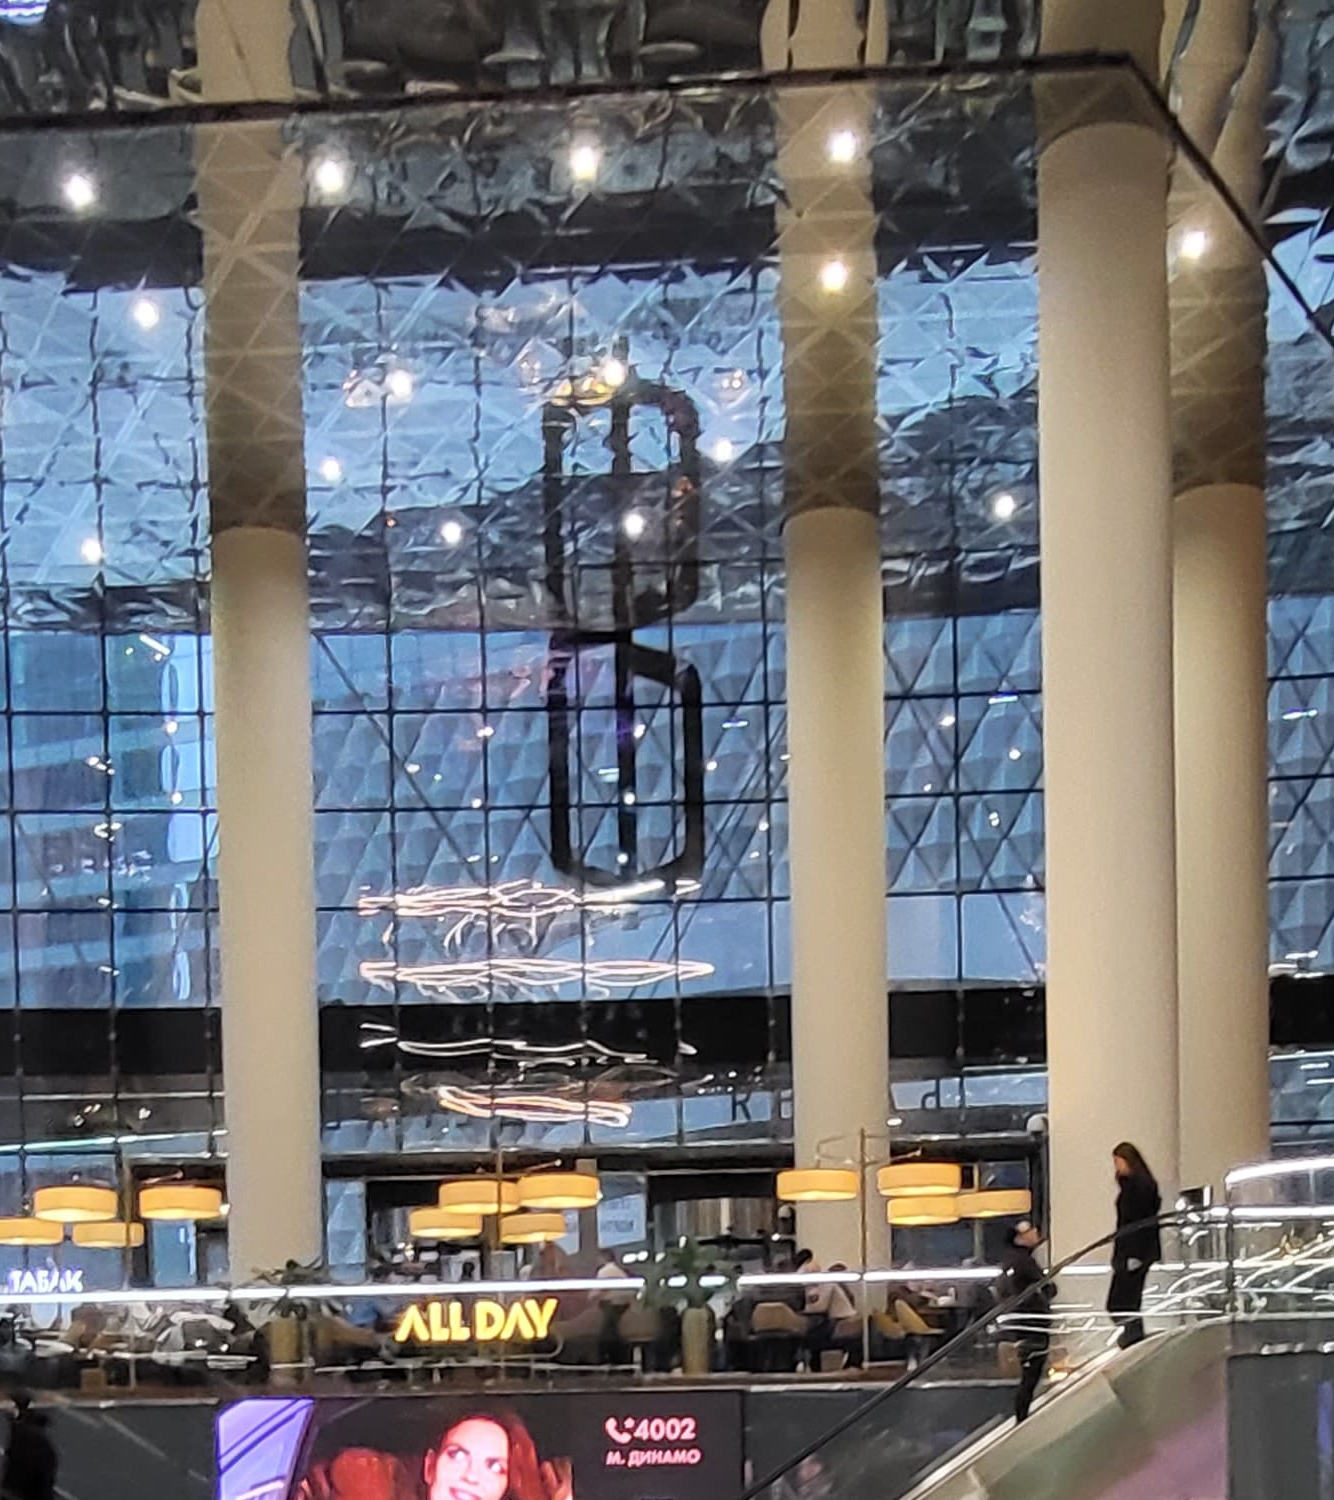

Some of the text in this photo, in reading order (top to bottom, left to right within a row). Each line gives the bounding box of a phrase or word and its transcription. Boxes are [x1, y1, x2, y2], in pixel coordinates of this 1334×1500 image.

[394, 1297, 559, 1343] ALL DAY
[605, 1448, 702, 1468] М. ДИНАМО
